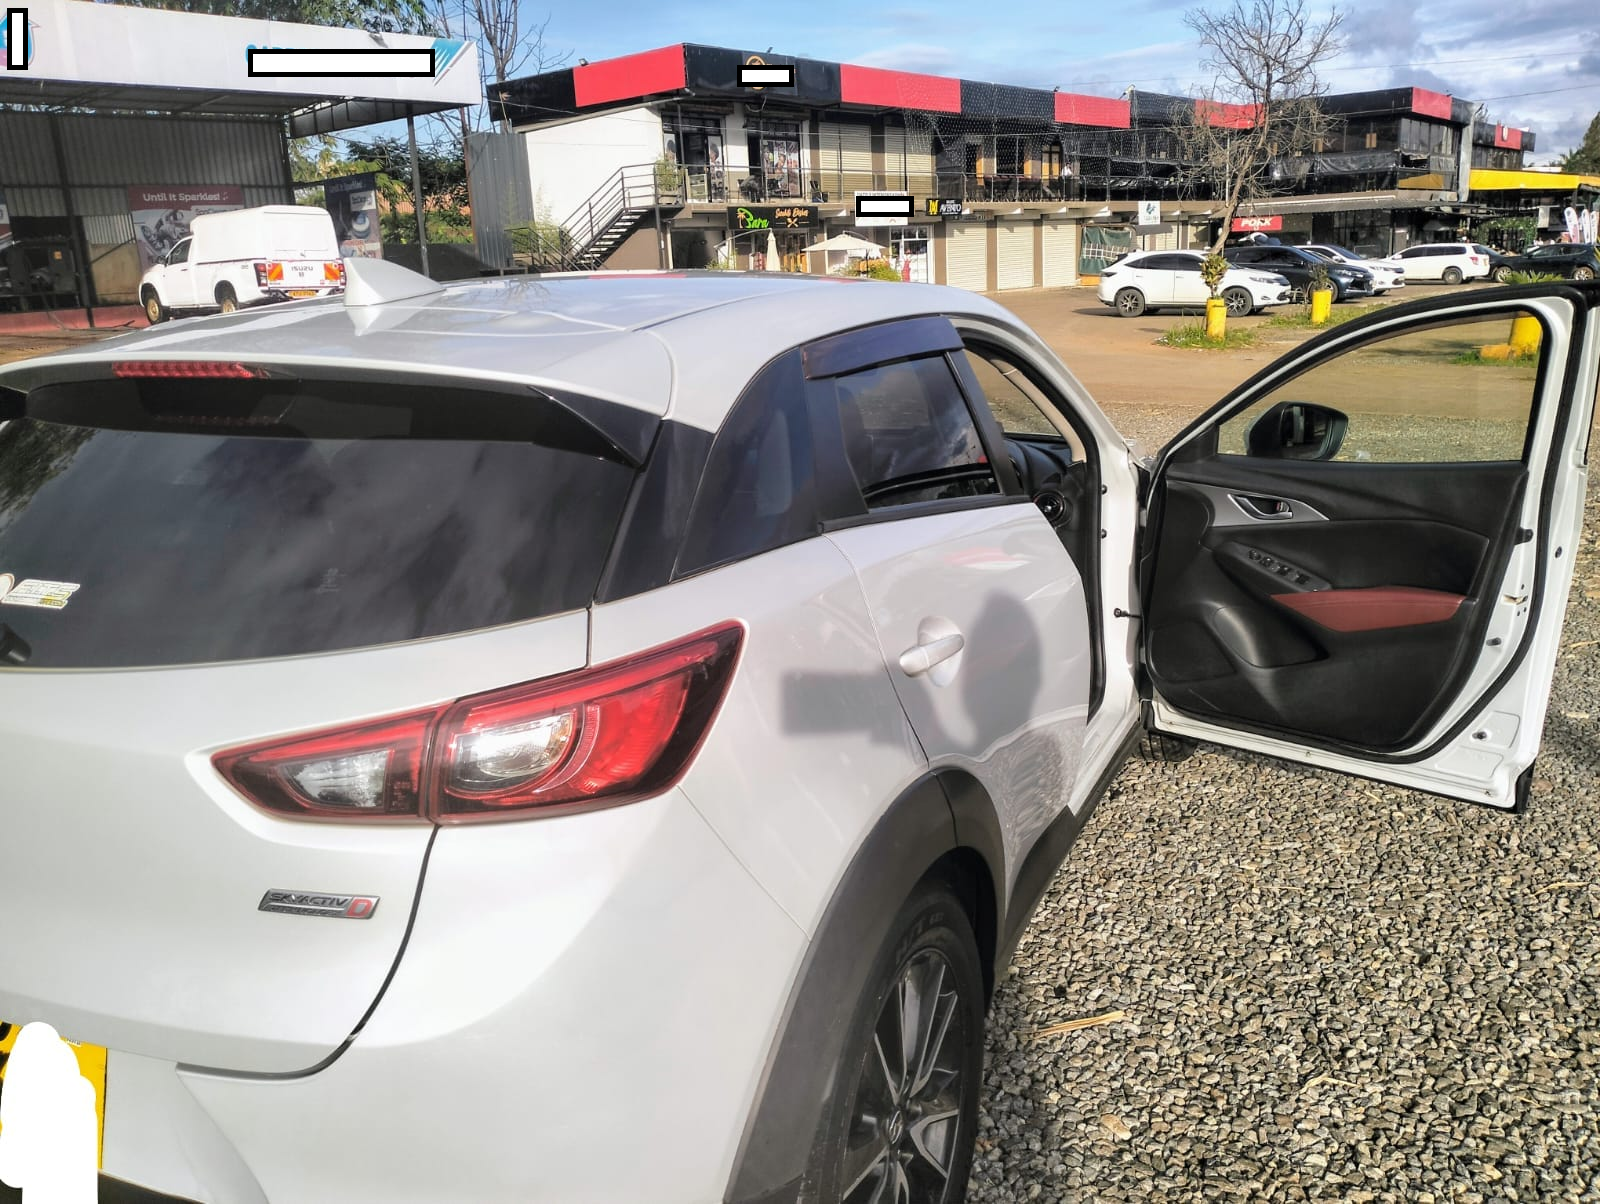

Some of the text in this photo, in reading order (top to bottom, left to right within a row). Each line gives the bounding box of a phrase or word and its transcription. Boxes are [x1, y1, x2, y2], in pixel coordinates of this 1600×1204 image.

[143, 192, 221, 203] Until It Sparkles!
[269, 892, 349, 906] SKYACTIV
[347, 898, 373, 917] D
